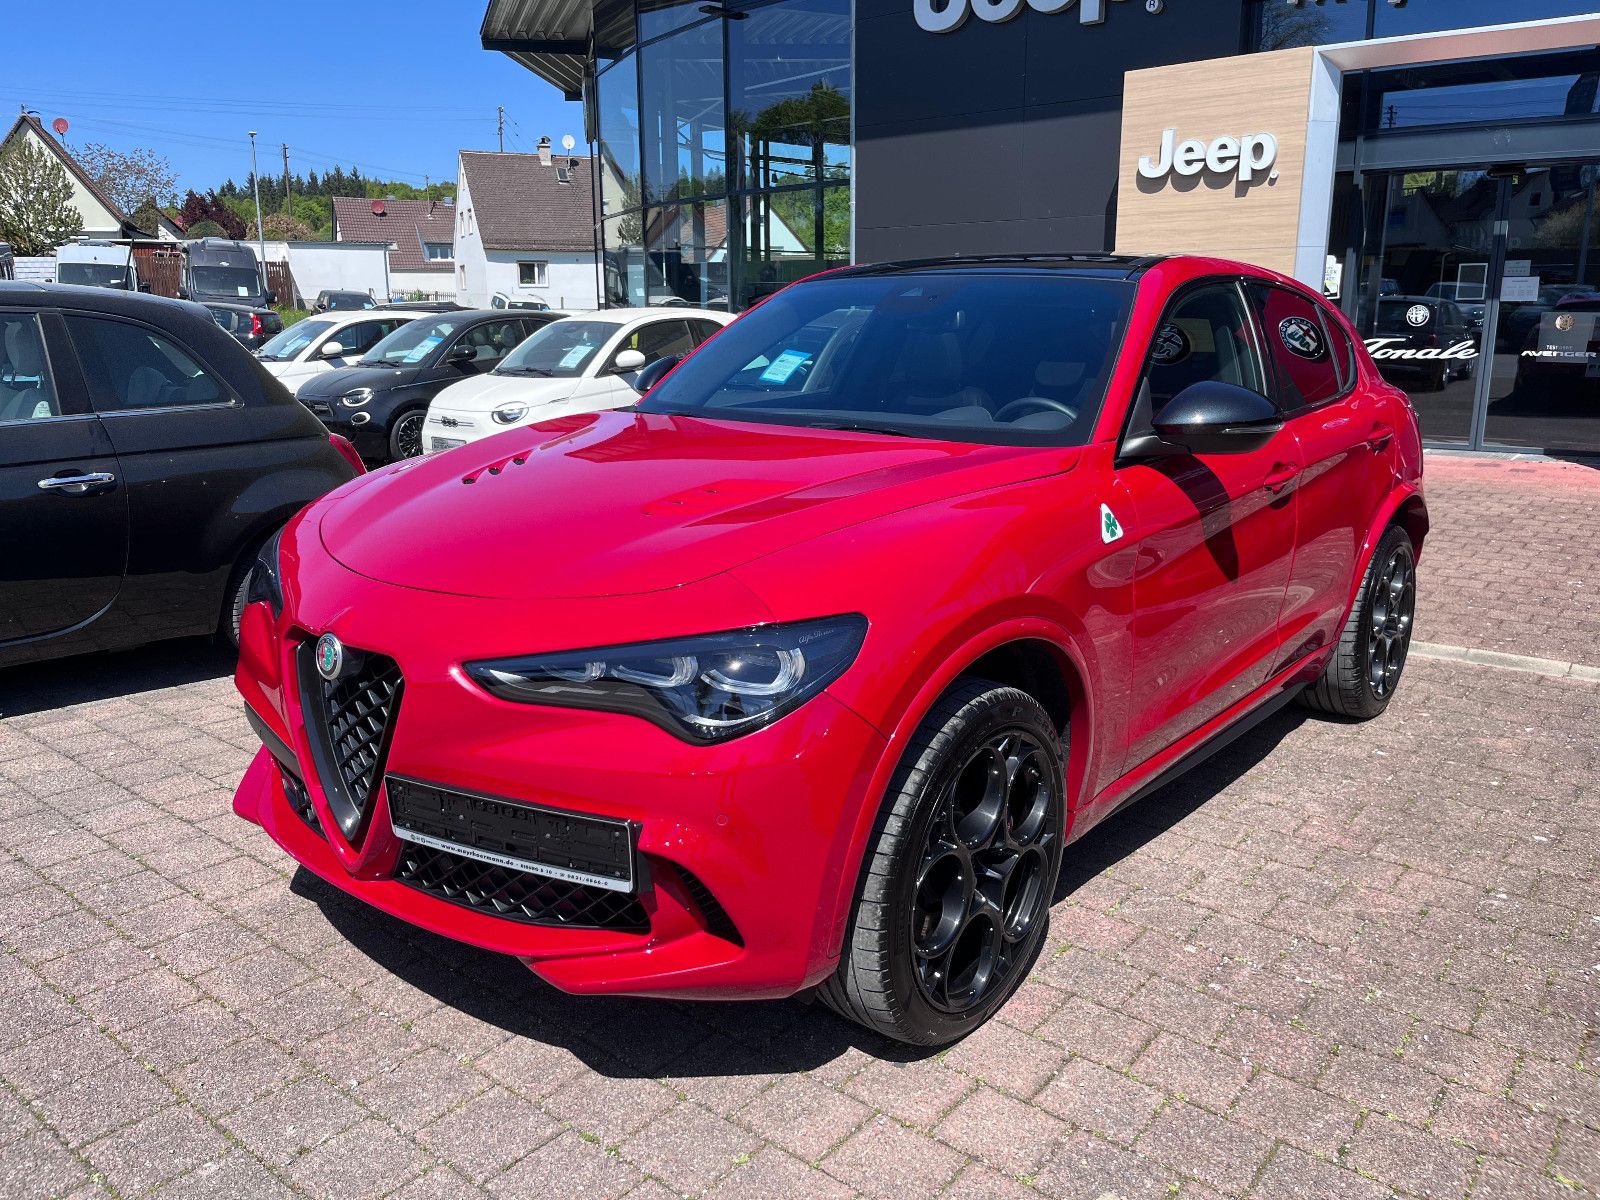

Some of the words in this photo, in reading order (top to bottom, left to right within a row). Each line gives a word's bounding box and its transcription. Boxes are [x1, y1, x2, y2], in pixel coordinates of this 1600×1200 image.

[1138, 128, 1278, 182] Jeep
[1362, 338, 1480, 360] Tonale
[1520, 350, 1598, 358] AVENGER
